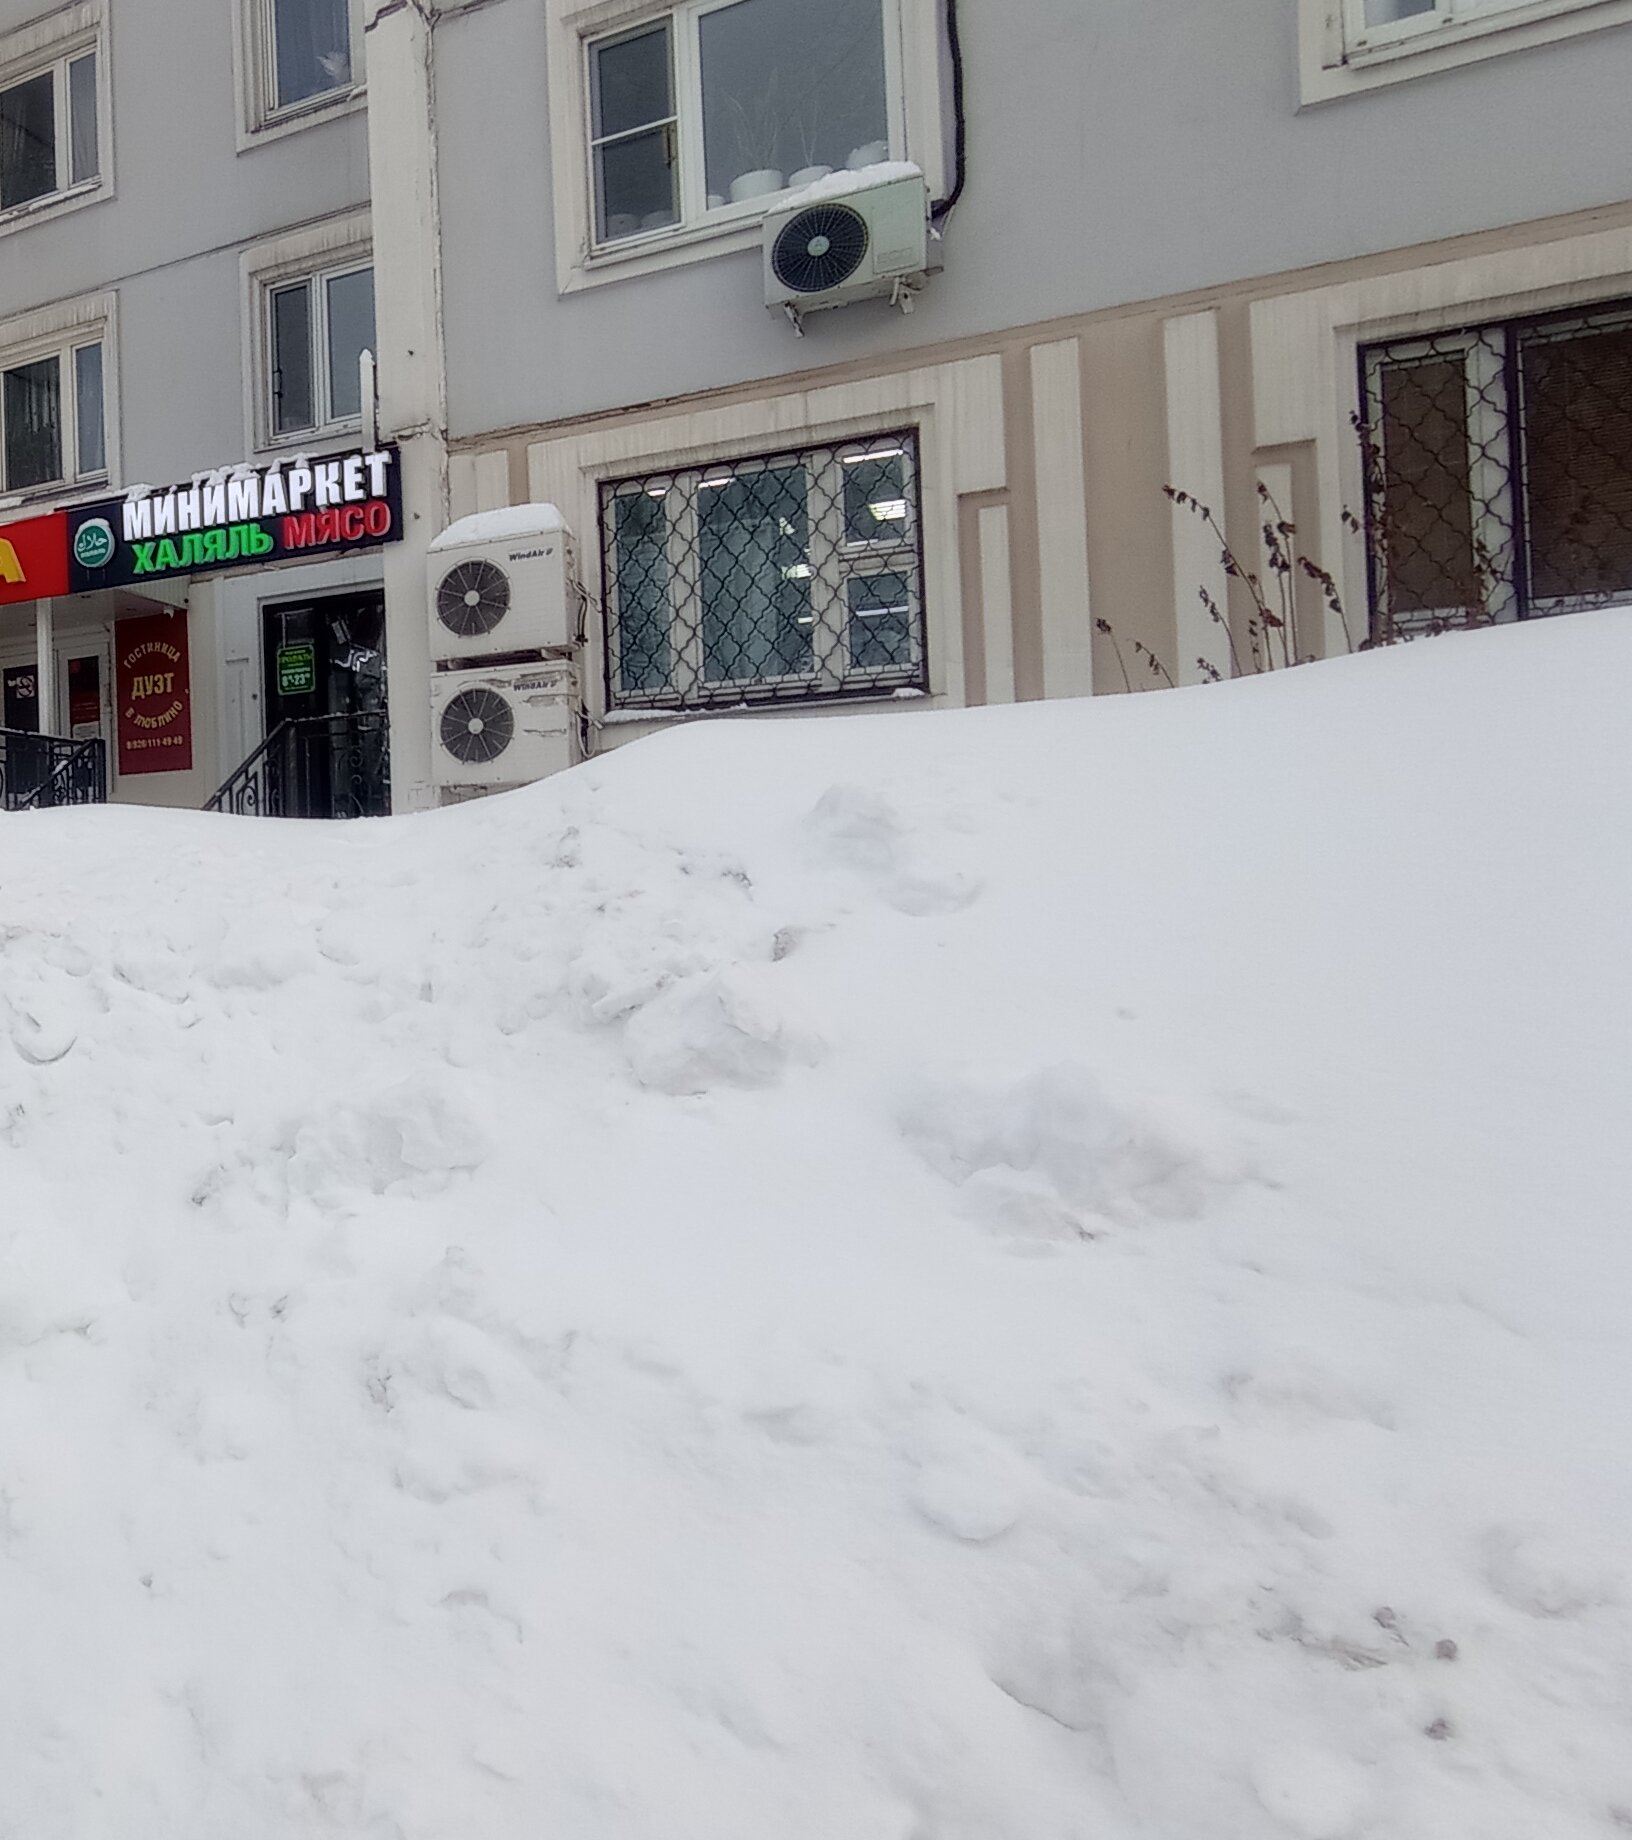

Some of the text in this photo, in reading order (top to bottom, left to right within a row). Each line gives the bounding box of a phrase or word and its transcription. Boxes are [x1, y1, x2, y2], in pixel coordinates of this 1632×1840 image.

[123, 453, 391, 541] МИНИМАРКЕТ
[132, 501, 391, 575] ХАЛЯЛЬ МЯСО
[123, 642, 181, 669] ГОСТИНИЦА
[131, 672, 175, 700] ДУЭТ
[133, 700, 183, 729] ЛЮБЛИНО
